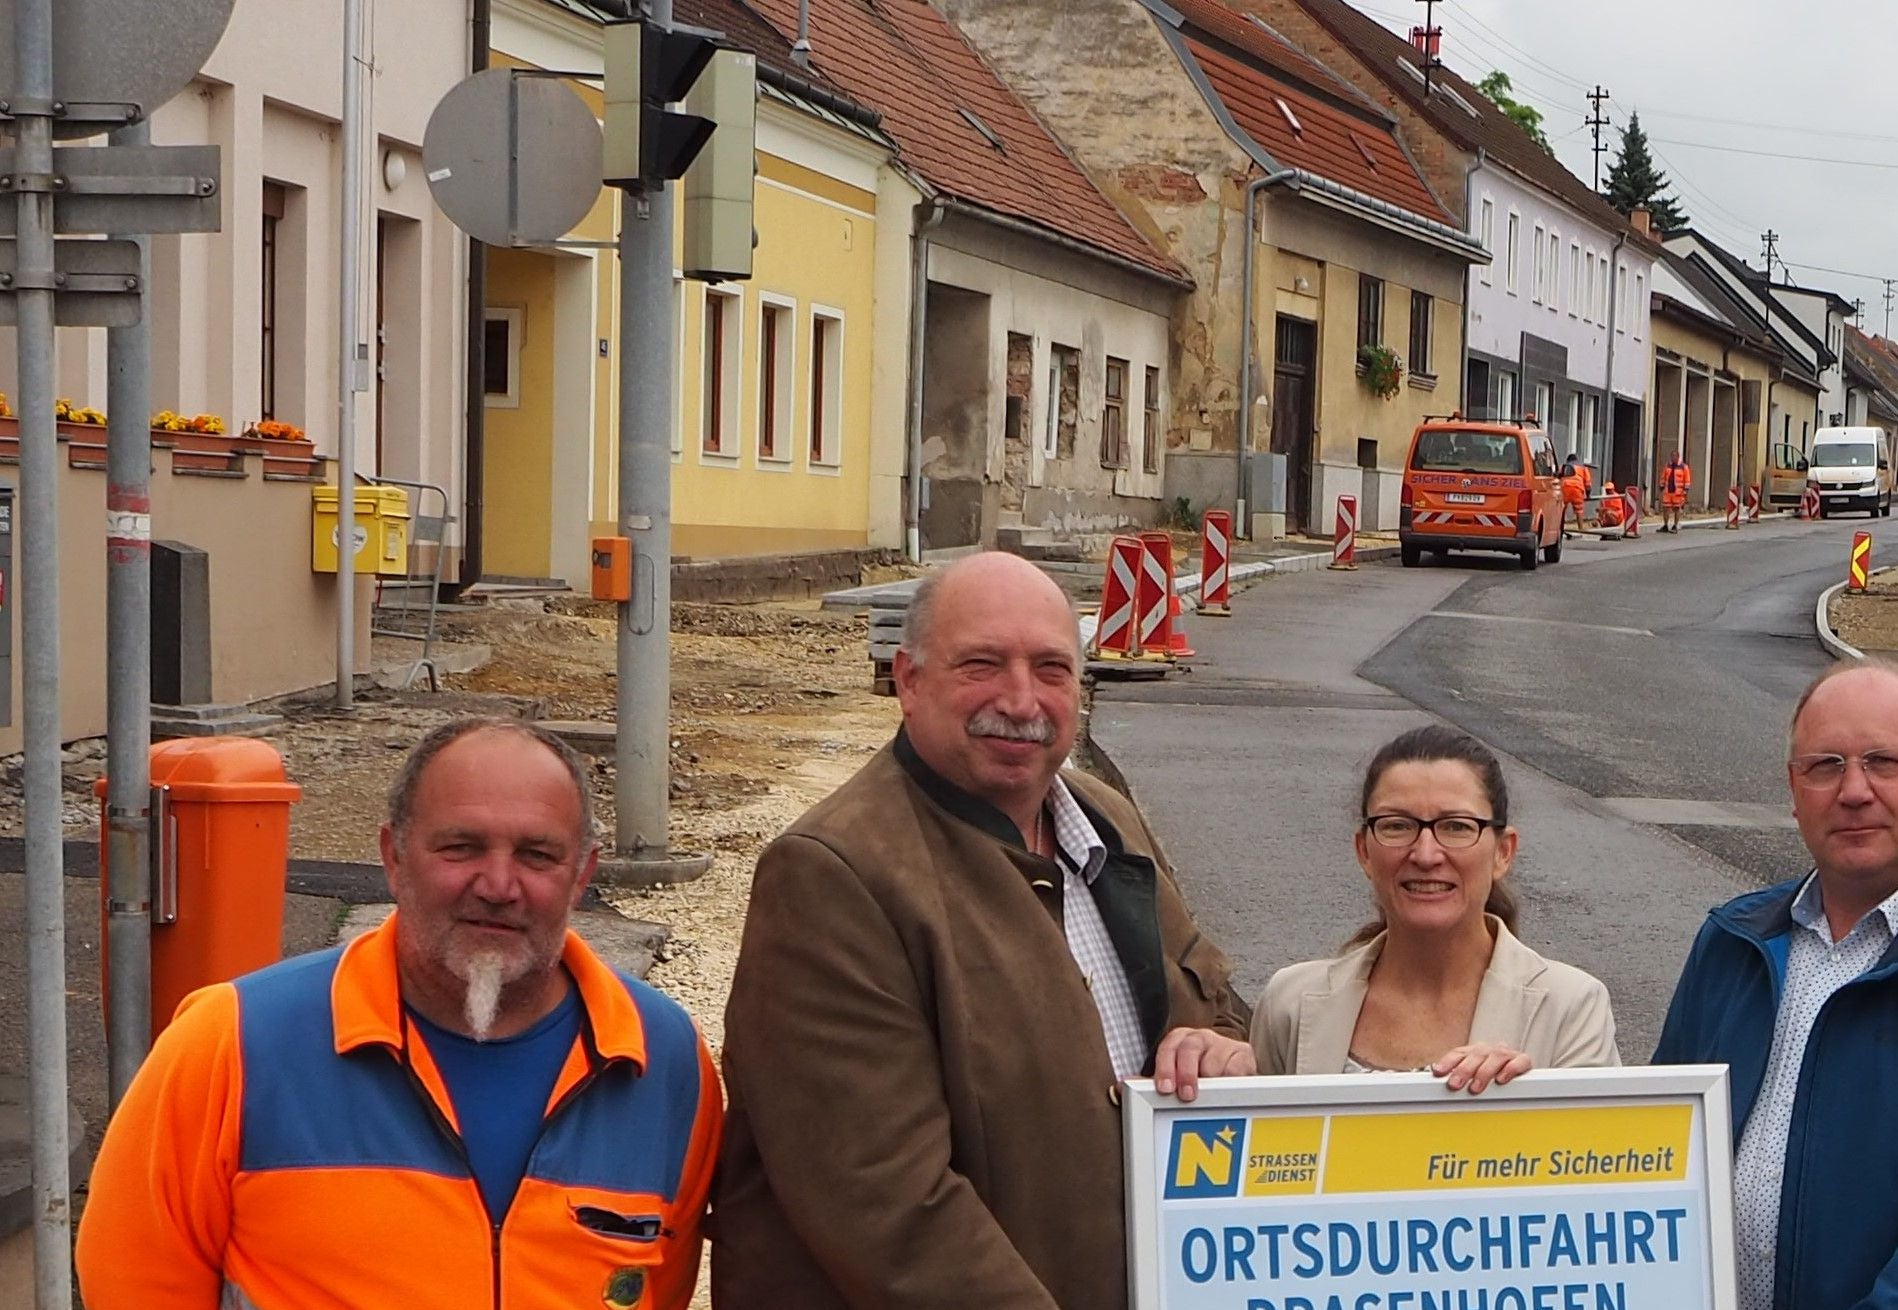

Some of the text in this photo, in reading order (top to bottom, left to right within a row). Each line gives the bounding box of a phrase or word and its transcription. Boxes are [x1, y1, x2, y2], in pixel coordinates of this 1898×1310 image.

[1412, 474, 1526, 488] SICHER ANS ZIEL
[1249, 1152, 1318, 1169] STRASSEN
[1428, 1146, 1674, 1181] Für mehr Sicherheit
[1267, 1167, 1316, 1183] DIENST
[1181, 1208, 1687, 1283] ORTSDURCHFAHRT
